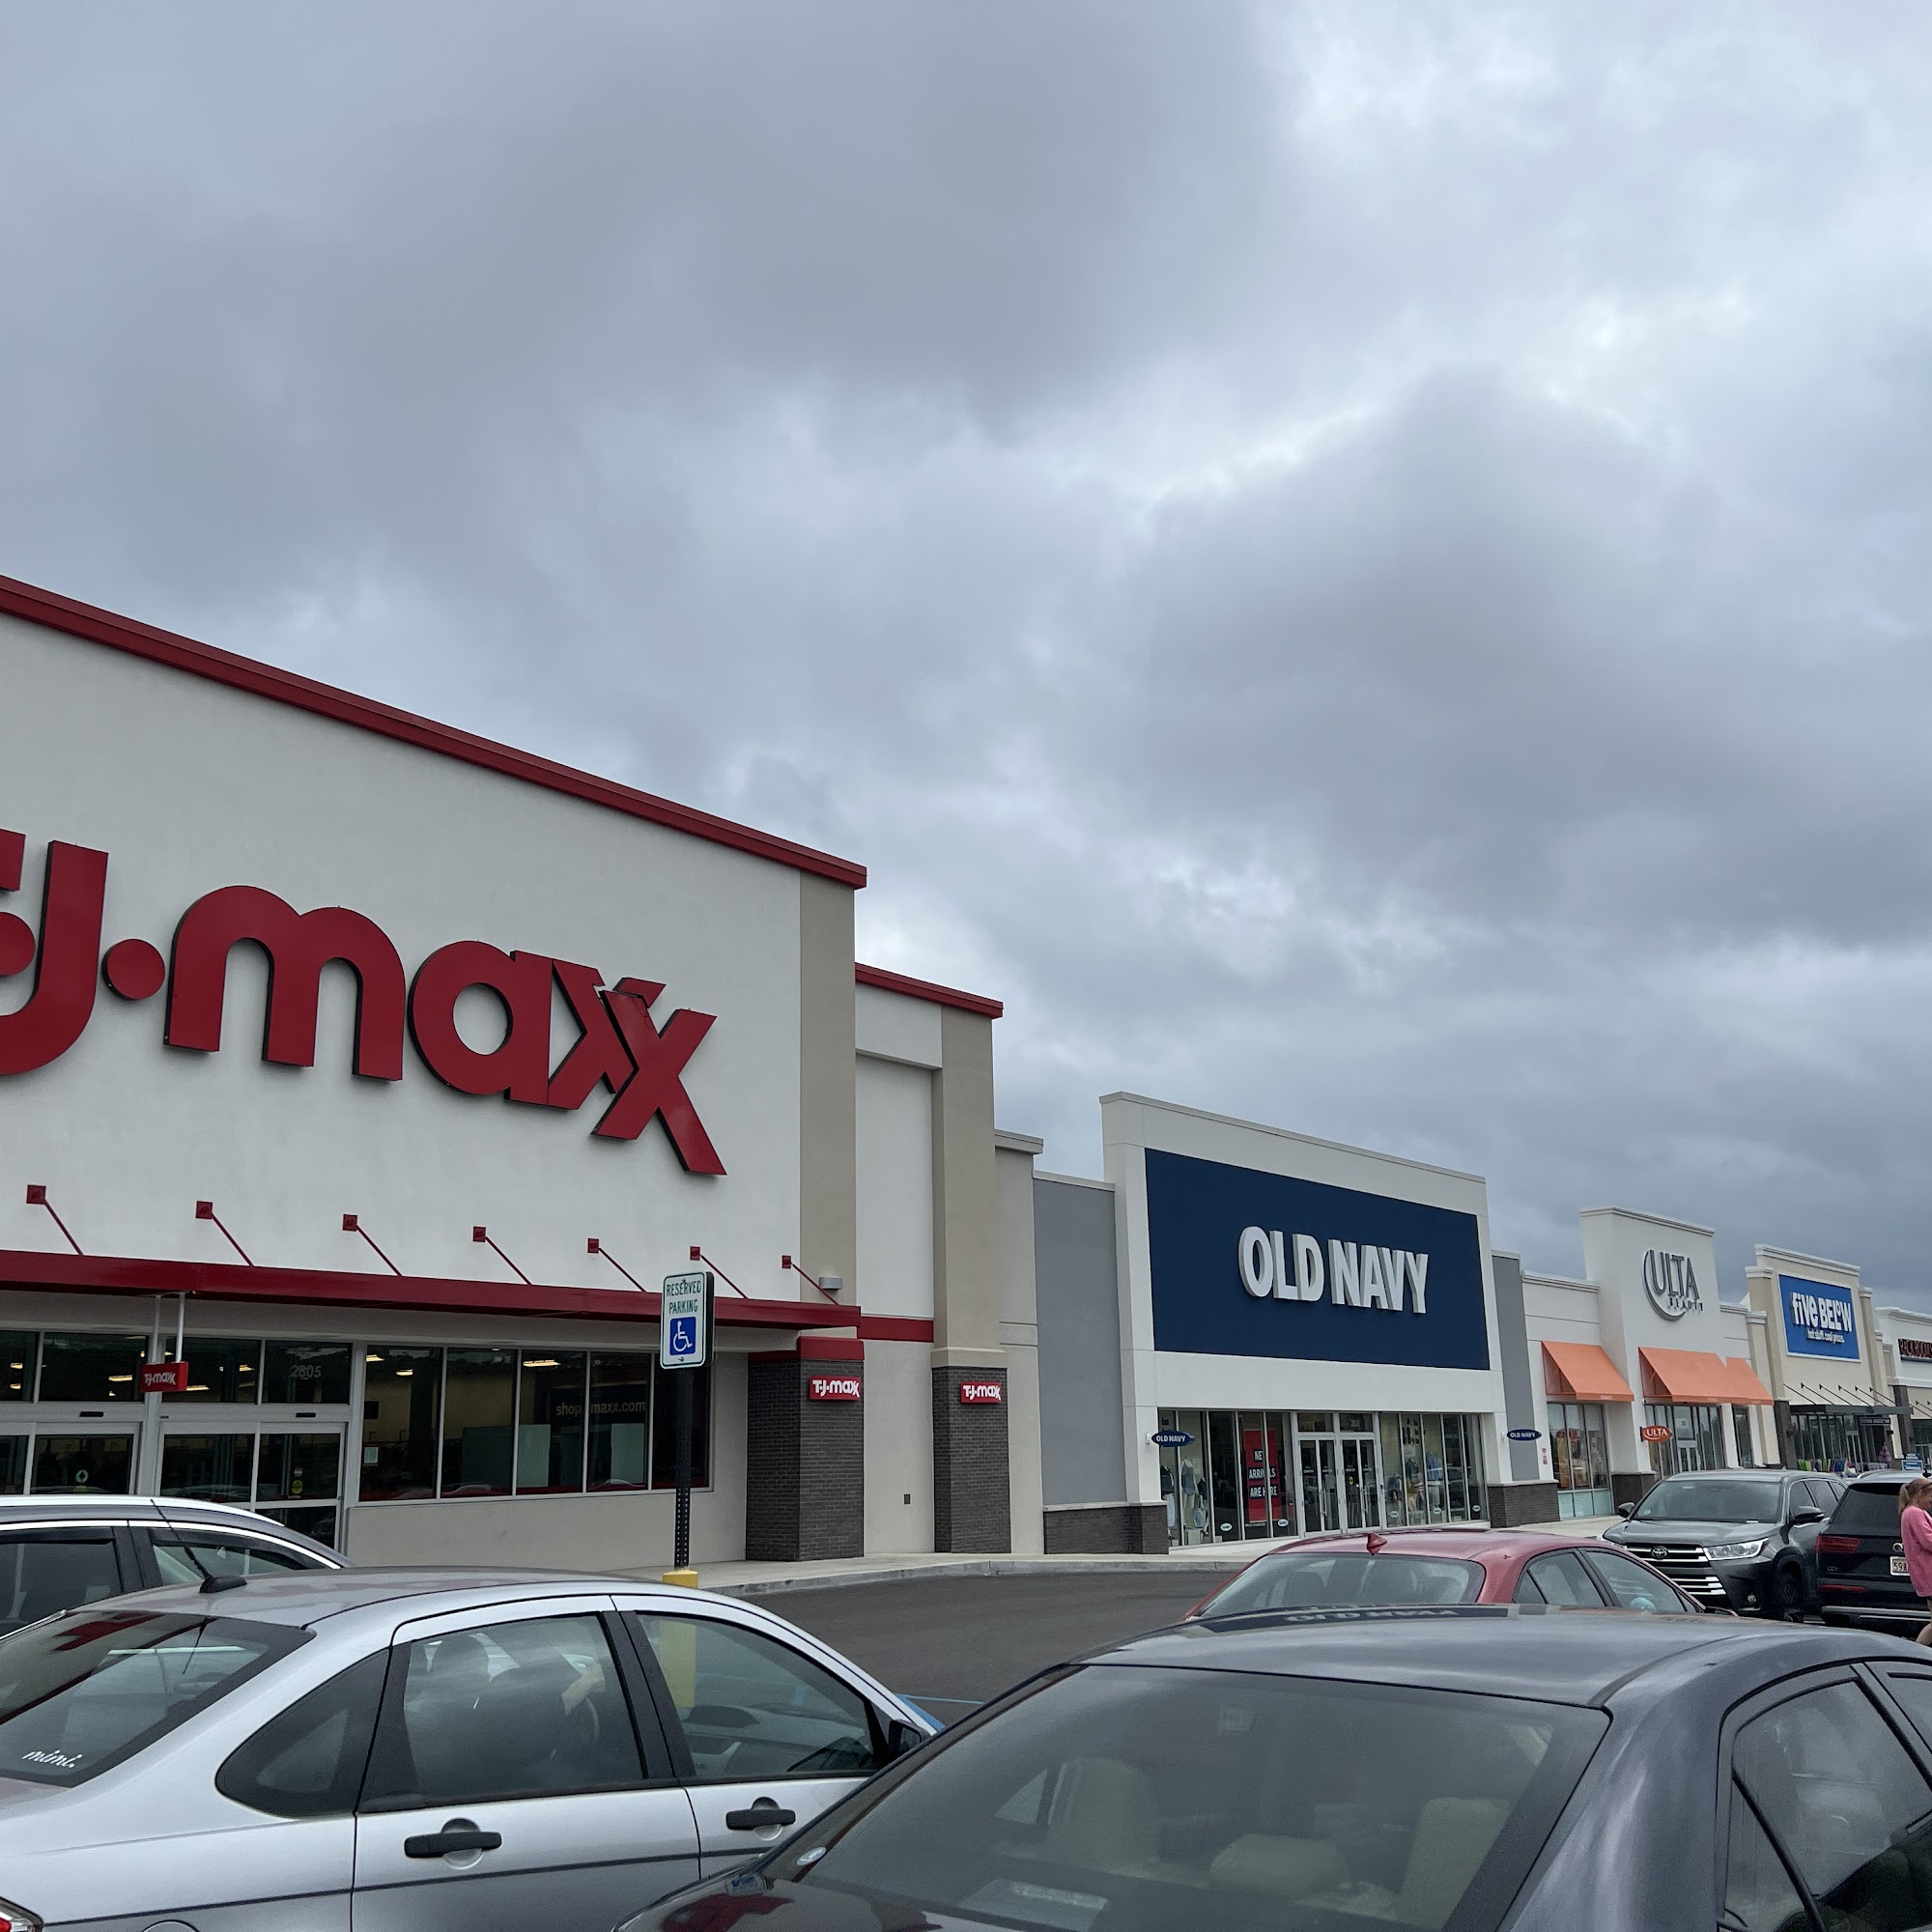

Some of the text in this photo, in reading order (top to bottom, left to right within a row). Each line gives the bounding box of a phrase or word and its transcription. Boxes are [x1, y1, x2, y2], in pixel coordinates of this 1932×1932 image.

[1238, 1226, 1429, 1314] OLD NAVY
[1648, 1249, 1700, 1300] ULTA
[667, 1280, 701, 1296] RESERVED
[669, 1299, 697, 1314] PARKING
[1792, 1292, 1819, 1327] five
[290, 1364, 322, 1378] 2805
[1646, 1428, 1668, 1437] ULTA
[1254, 1450, 1264, 1461] NE
[1250, 1486, 1278, 1498] ARE HRE
